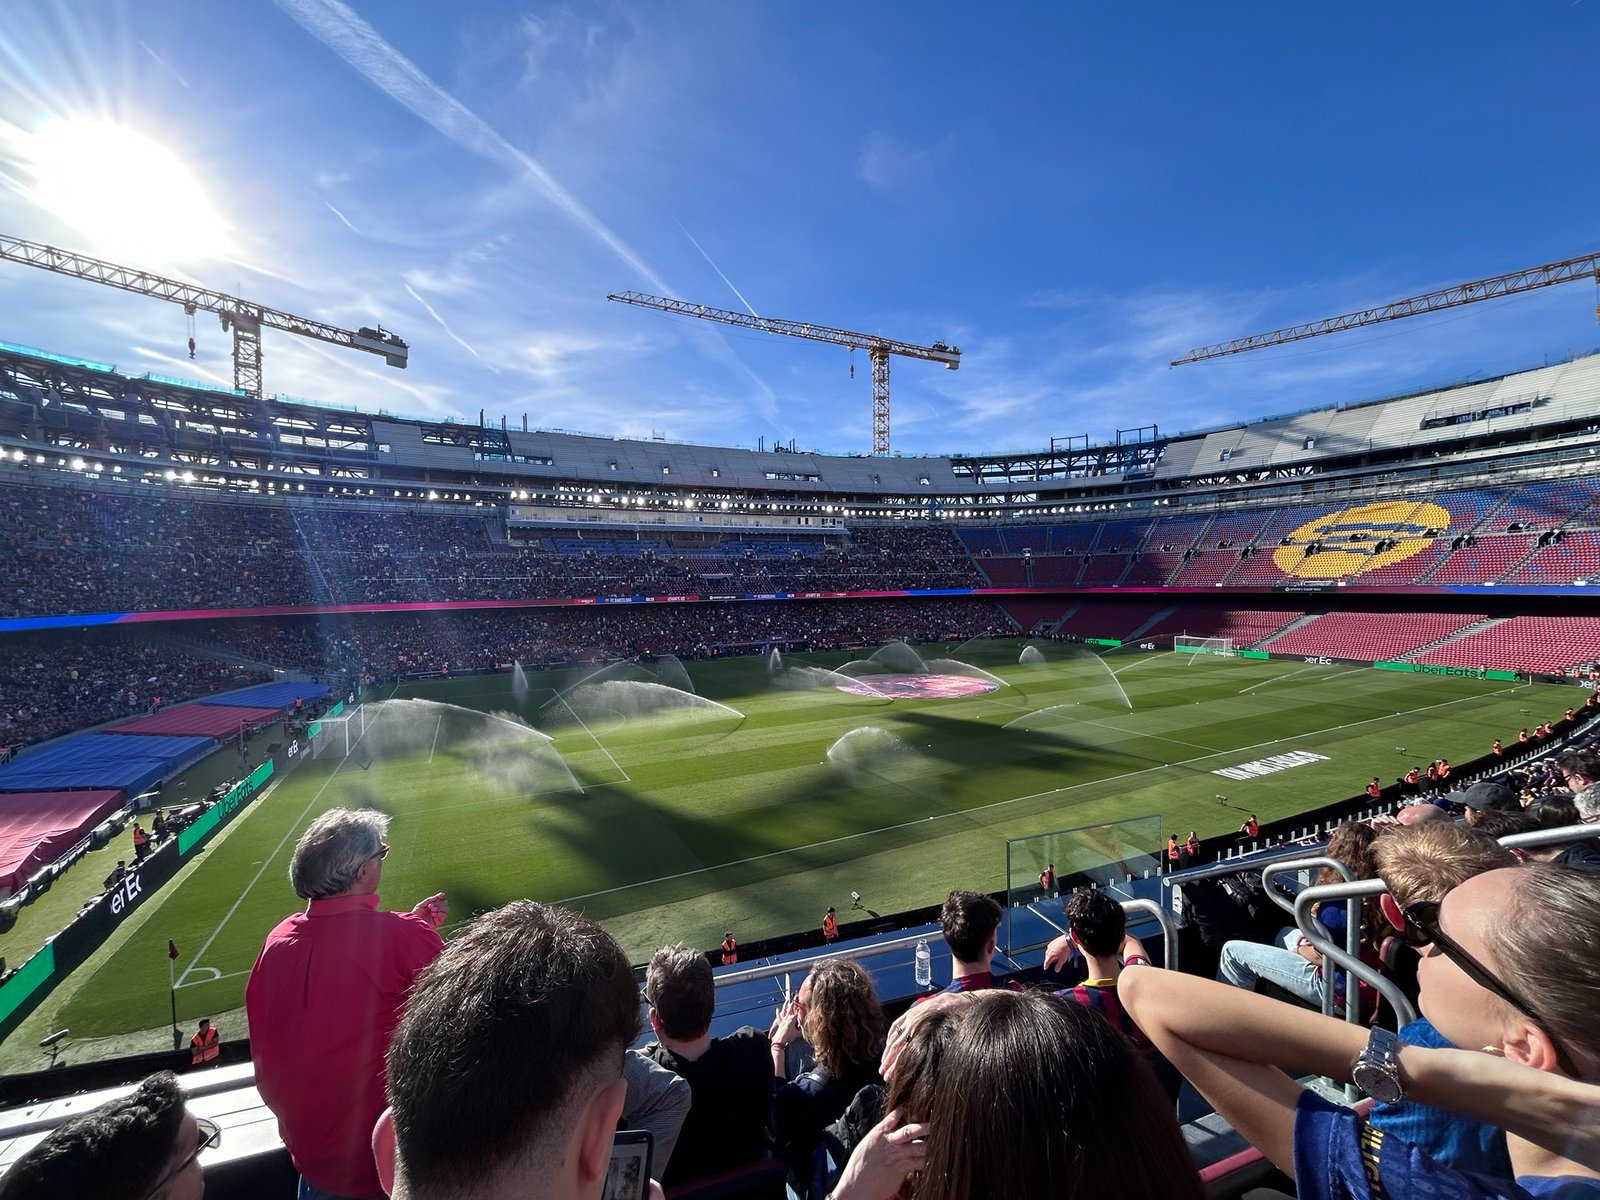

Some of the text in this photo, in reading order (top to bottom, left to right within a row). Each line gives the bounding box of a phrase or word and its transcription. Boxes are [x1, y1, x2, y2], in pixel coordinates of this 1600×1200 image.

[1413, 664, 1478, 678] Uber Eats
[217, 780, 254, 819] Uber Eats
